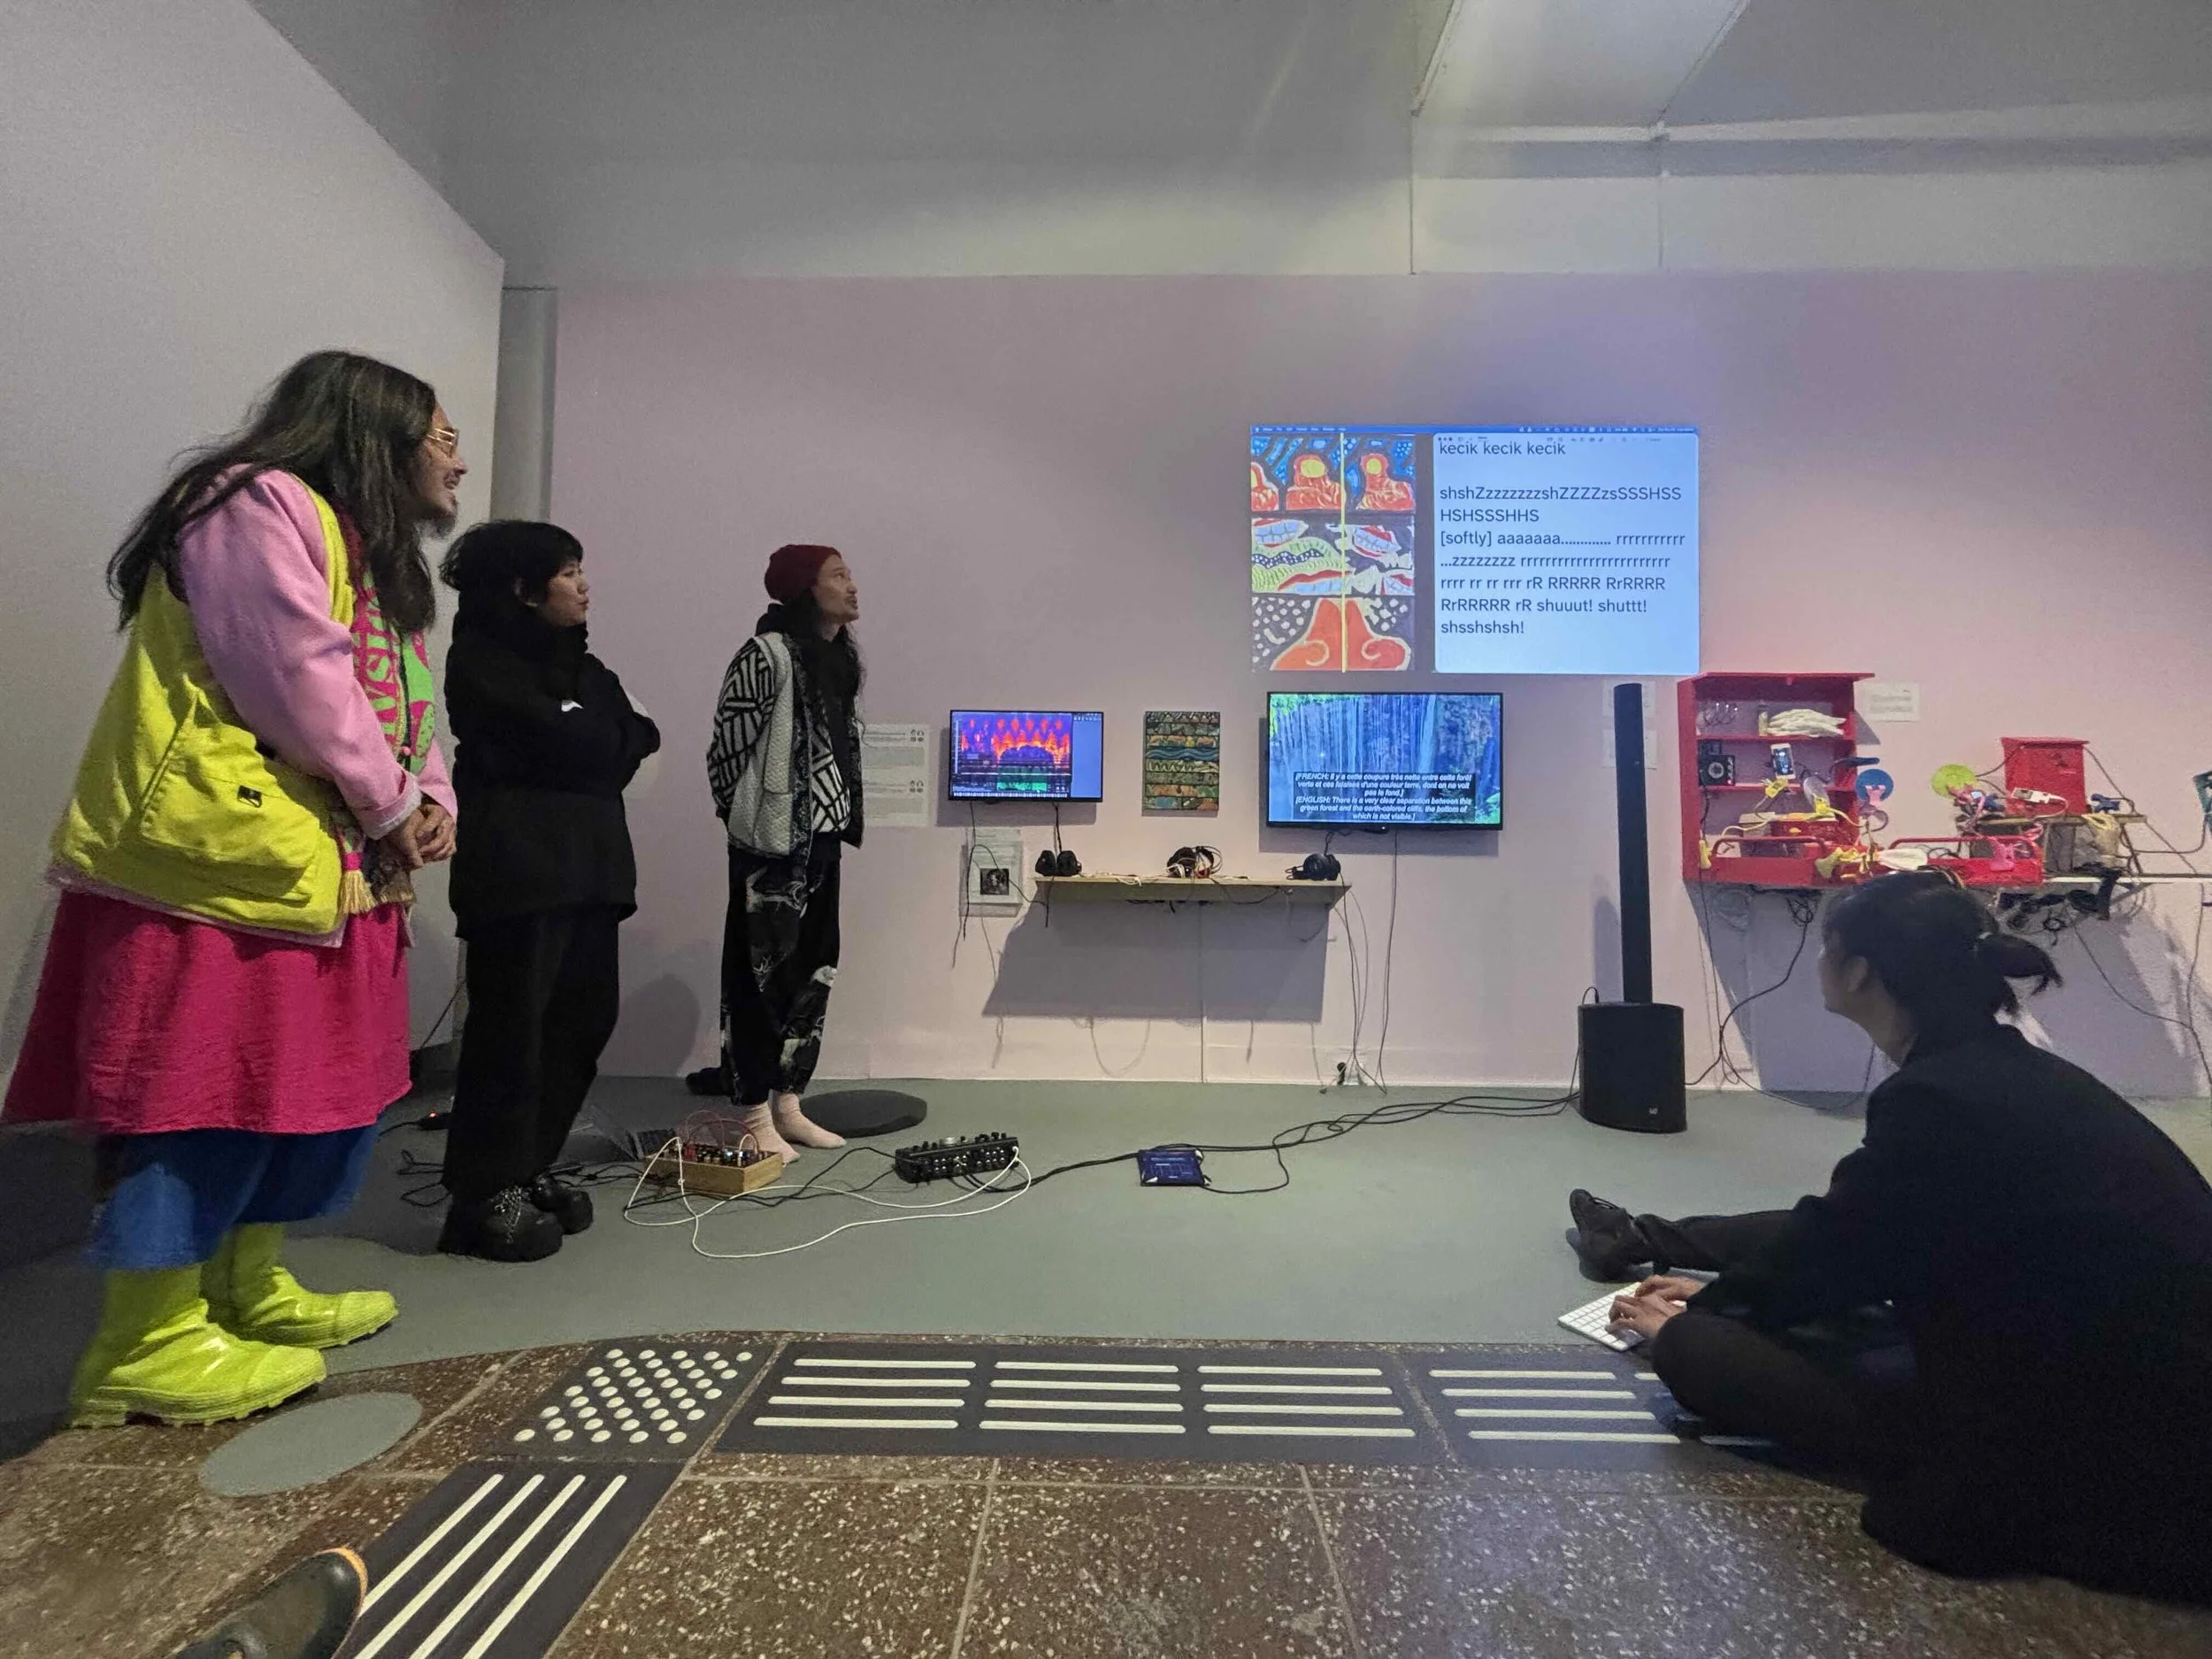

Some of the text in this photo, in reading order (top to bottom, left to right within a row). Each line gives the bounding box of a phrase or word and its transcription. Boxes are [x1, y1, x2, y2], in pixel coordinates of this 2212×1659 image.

[1440, 441, 1566, 456] kecik kecik kecik
[1440, 509, 1540, 523] HSHSSSHHS
[1440, 531, 1492, 547] [softly]
[1440, 576, 1665, 590] rrrr rr rr rrr rR RRRRR RrRRRR
[1440, 598, 1647, 612] RrRRRRR rR shuuut! shuttt!
[1440, 619, 1524, 634] shsshshsh!
